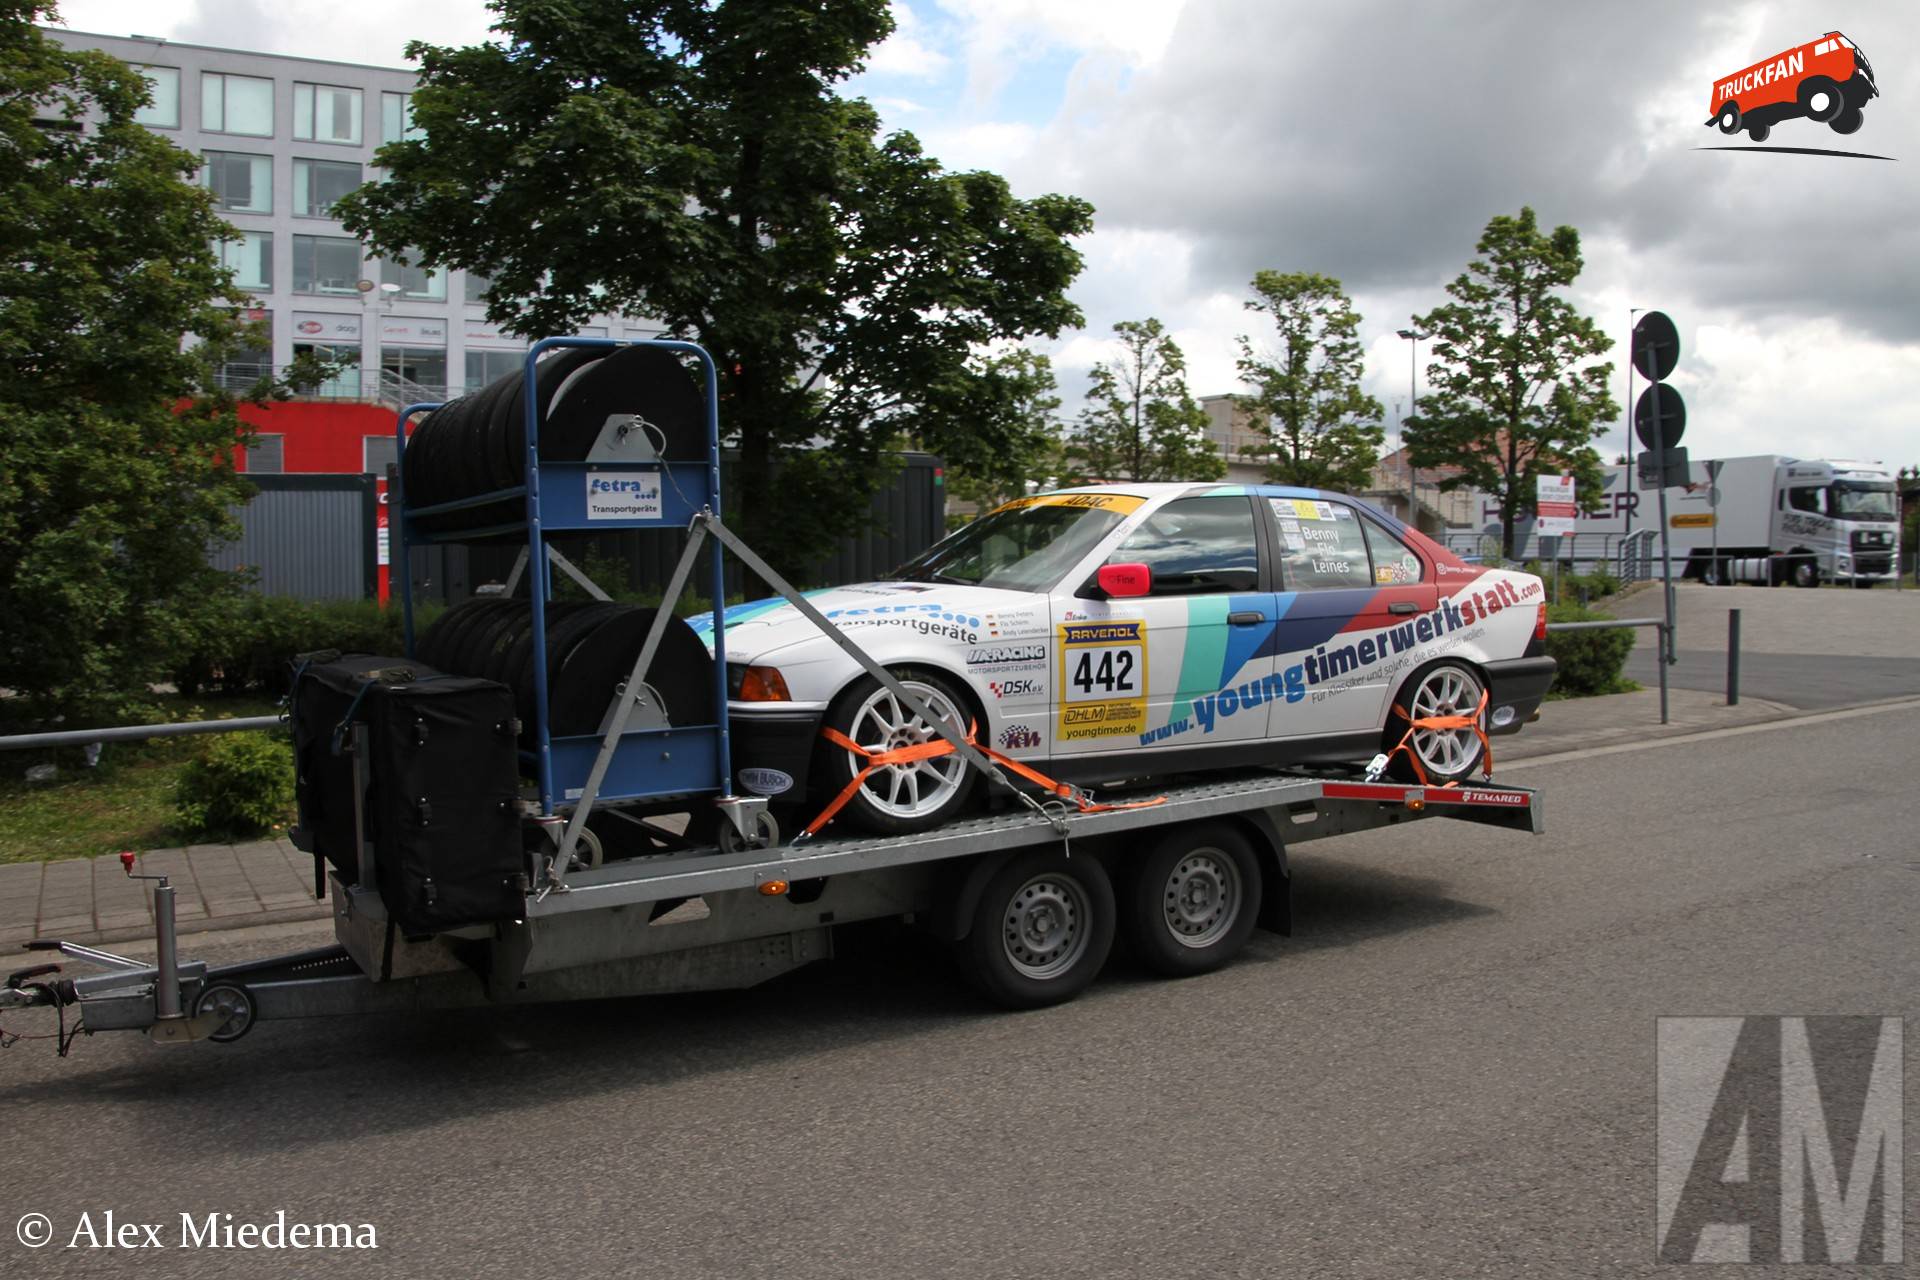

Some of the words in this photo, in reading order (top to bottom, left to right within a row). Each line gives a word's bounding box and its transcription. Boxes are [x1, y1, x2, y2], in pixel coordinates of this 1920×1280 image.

[592, 479, 641, 492] fetra
[1063, 495, 1113, 508] ADAC
[592, 505, 658, 515] Transportgeräte
[1302, 526, 1340, 544] Benny
[1316, 542, 1336, 555] Flo
[1312, 559, 1350, 574] Leines
[1116, 575, 1136, 585] Fine
[833, 618, 978, 645] ransportgeräte
[1071, 628, 1134, 640] RAVENOL
[1139, 578, 1542, 746] www.youngtimerwerkstatt.com
[1074, 650, 1133, 693] 442
[1311, 690, 1326, 705] Für
[1328, 676, 1366, 697] Klassiker
[1367, 666, 1383, 681] und
[1413, 651, 1426, 664] die
[1428, 647, 1438, 657] es
[1004, 679, 1033, 694] DSK
[1065, 707, 1103, 721] DHLM
[1066, 723, 1136, 740] youngtimer.de
[1472, 792, 1522, 803] TEMARED
